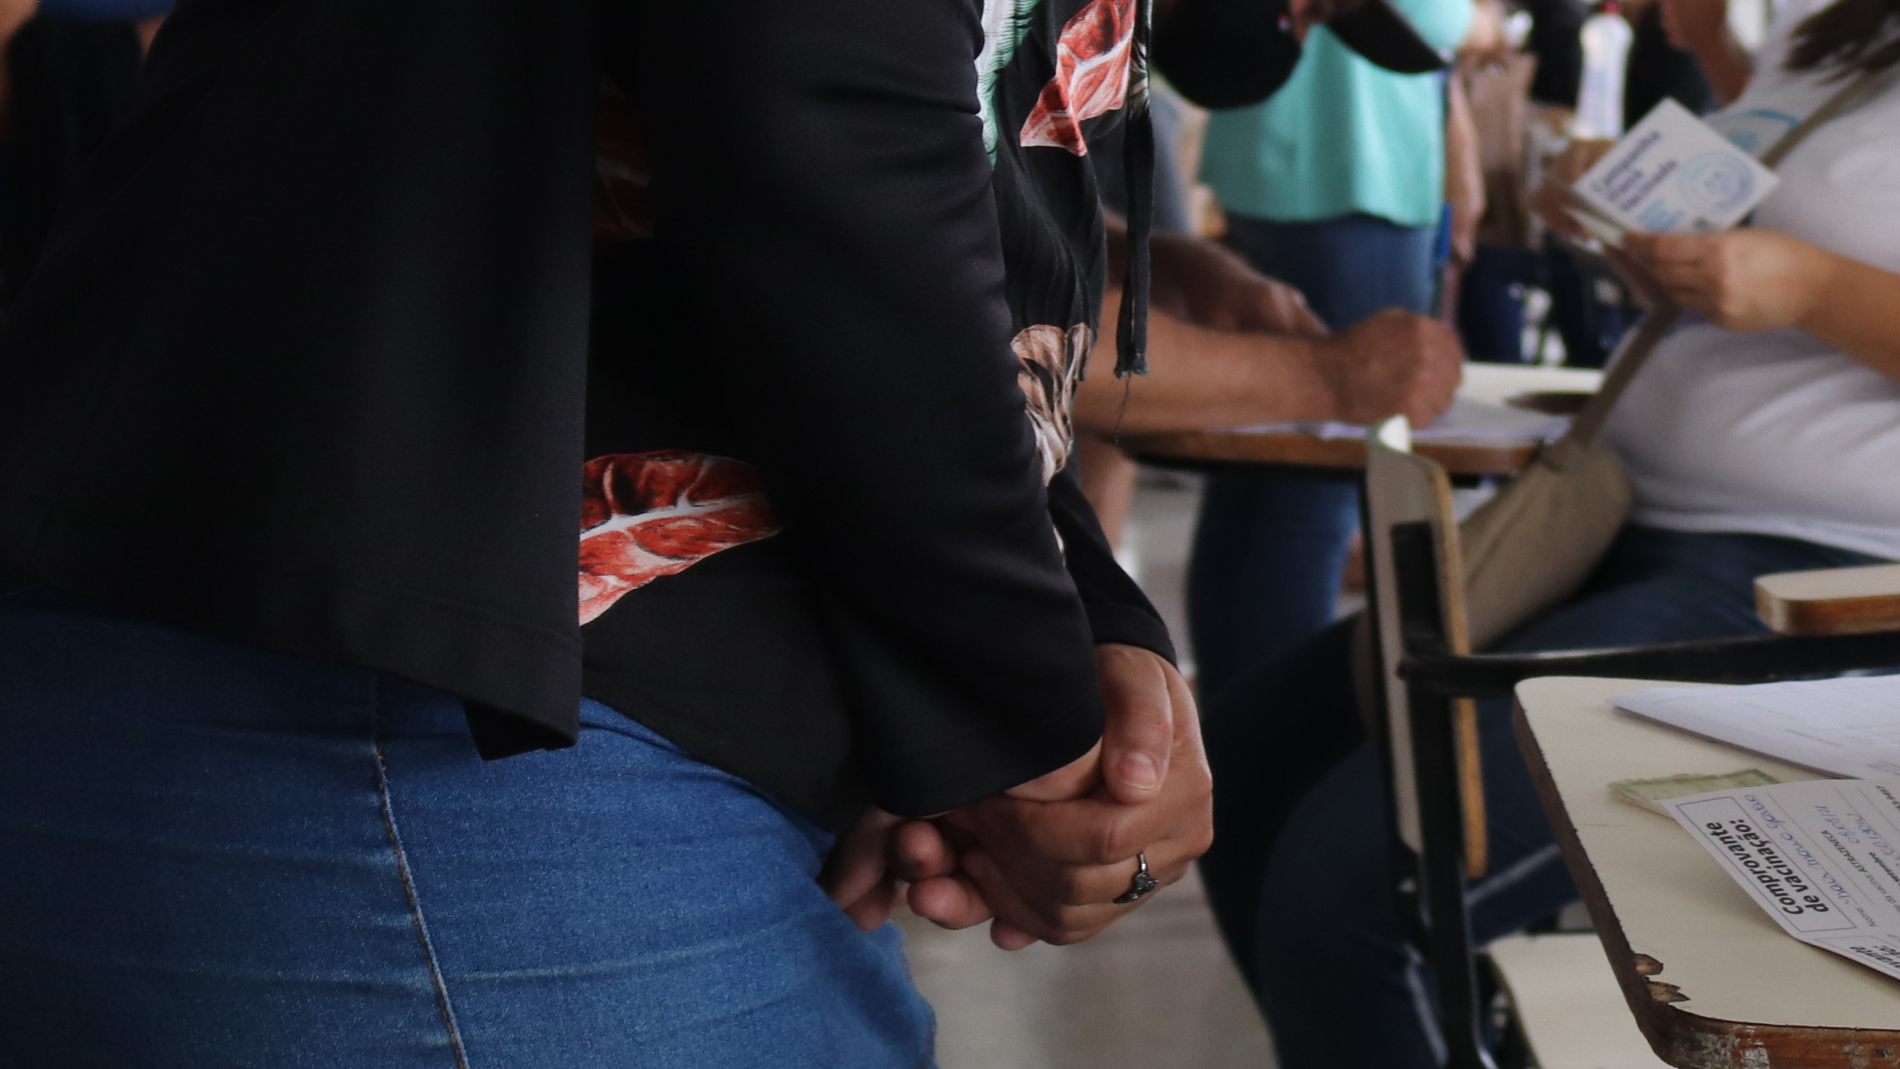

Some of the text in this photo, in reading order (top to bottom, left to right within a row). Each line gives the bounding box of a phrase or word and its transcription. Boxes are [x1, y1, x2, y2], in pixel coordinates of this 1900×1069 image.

[1706, 821, 1804, 915] Comprovante
[1729, 819, 1829, 913] de vacinação:
[1821, 830, 1868, 873] ASTRAZENECA
[1868, 852, 1900, 884] setembro
